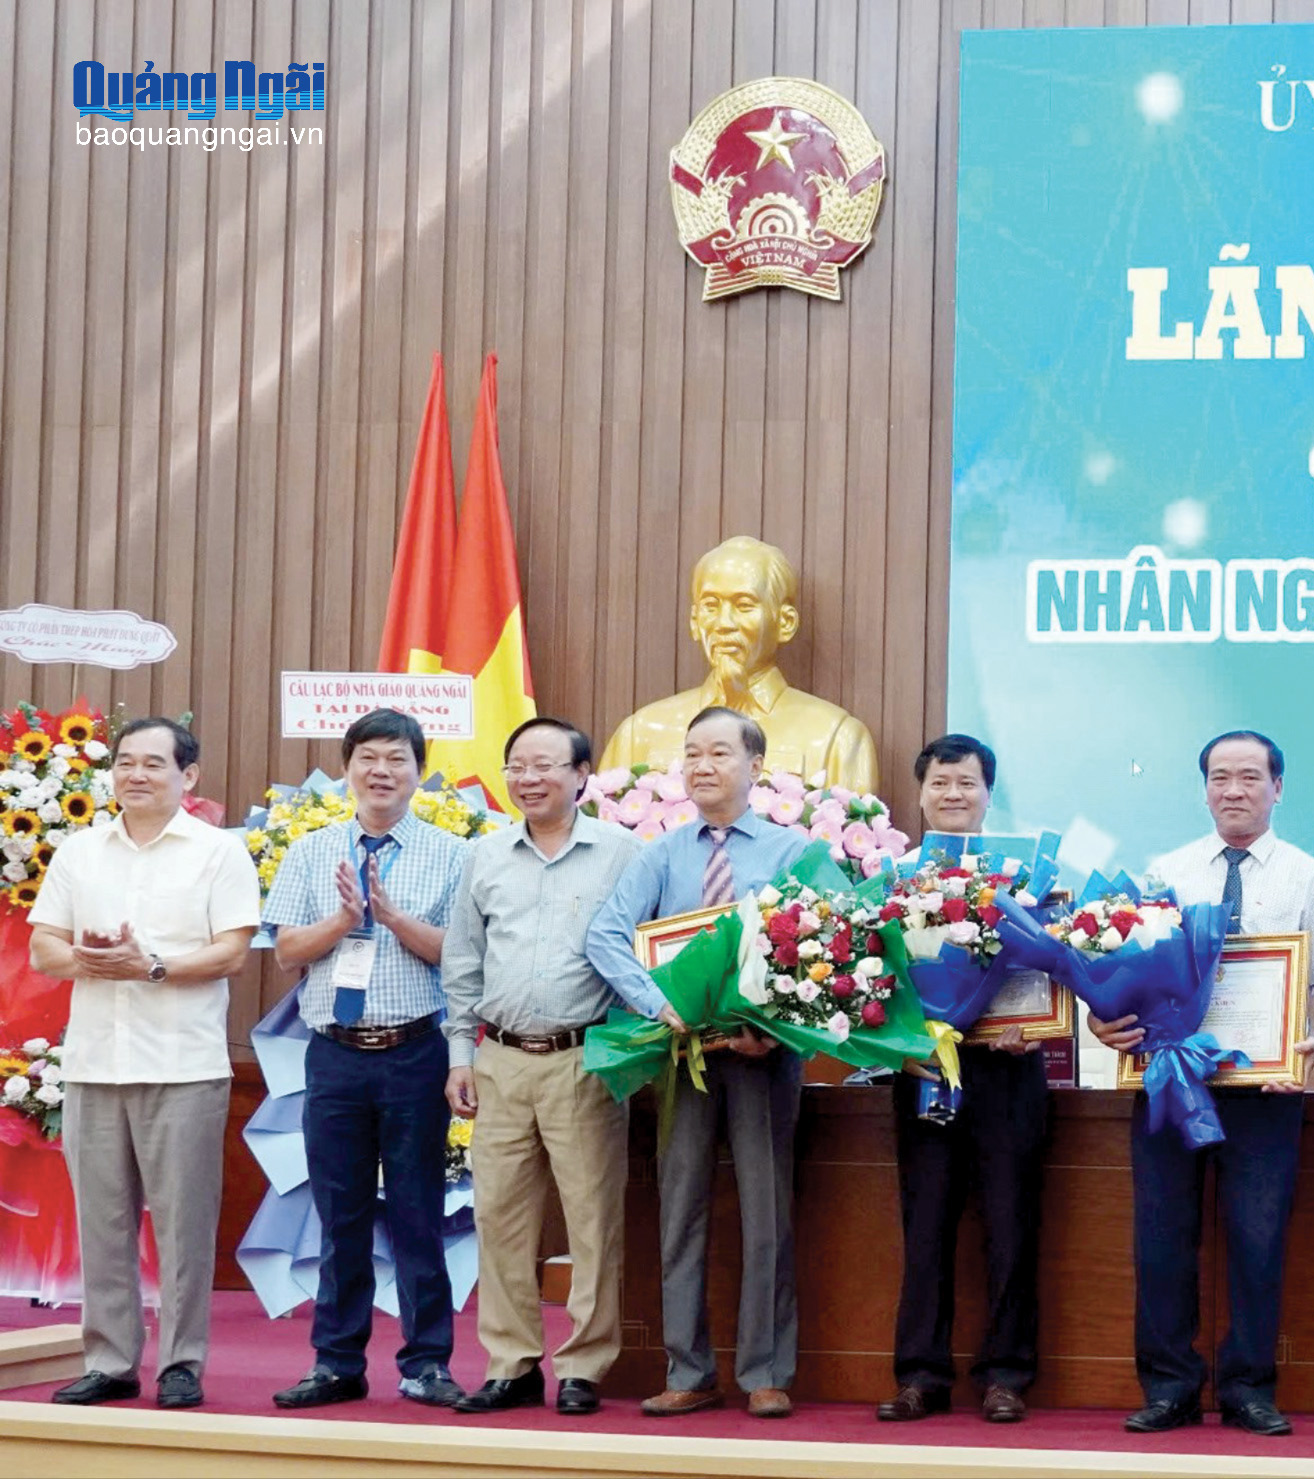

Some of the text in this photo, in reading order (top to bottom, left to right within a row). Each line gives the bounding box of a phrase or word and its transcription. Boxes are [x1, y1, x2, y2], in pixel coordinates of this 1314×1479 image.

[740, 252, 806, 268] VIỆT NAM
[1033, 554, 1216, 636] NHÂN
